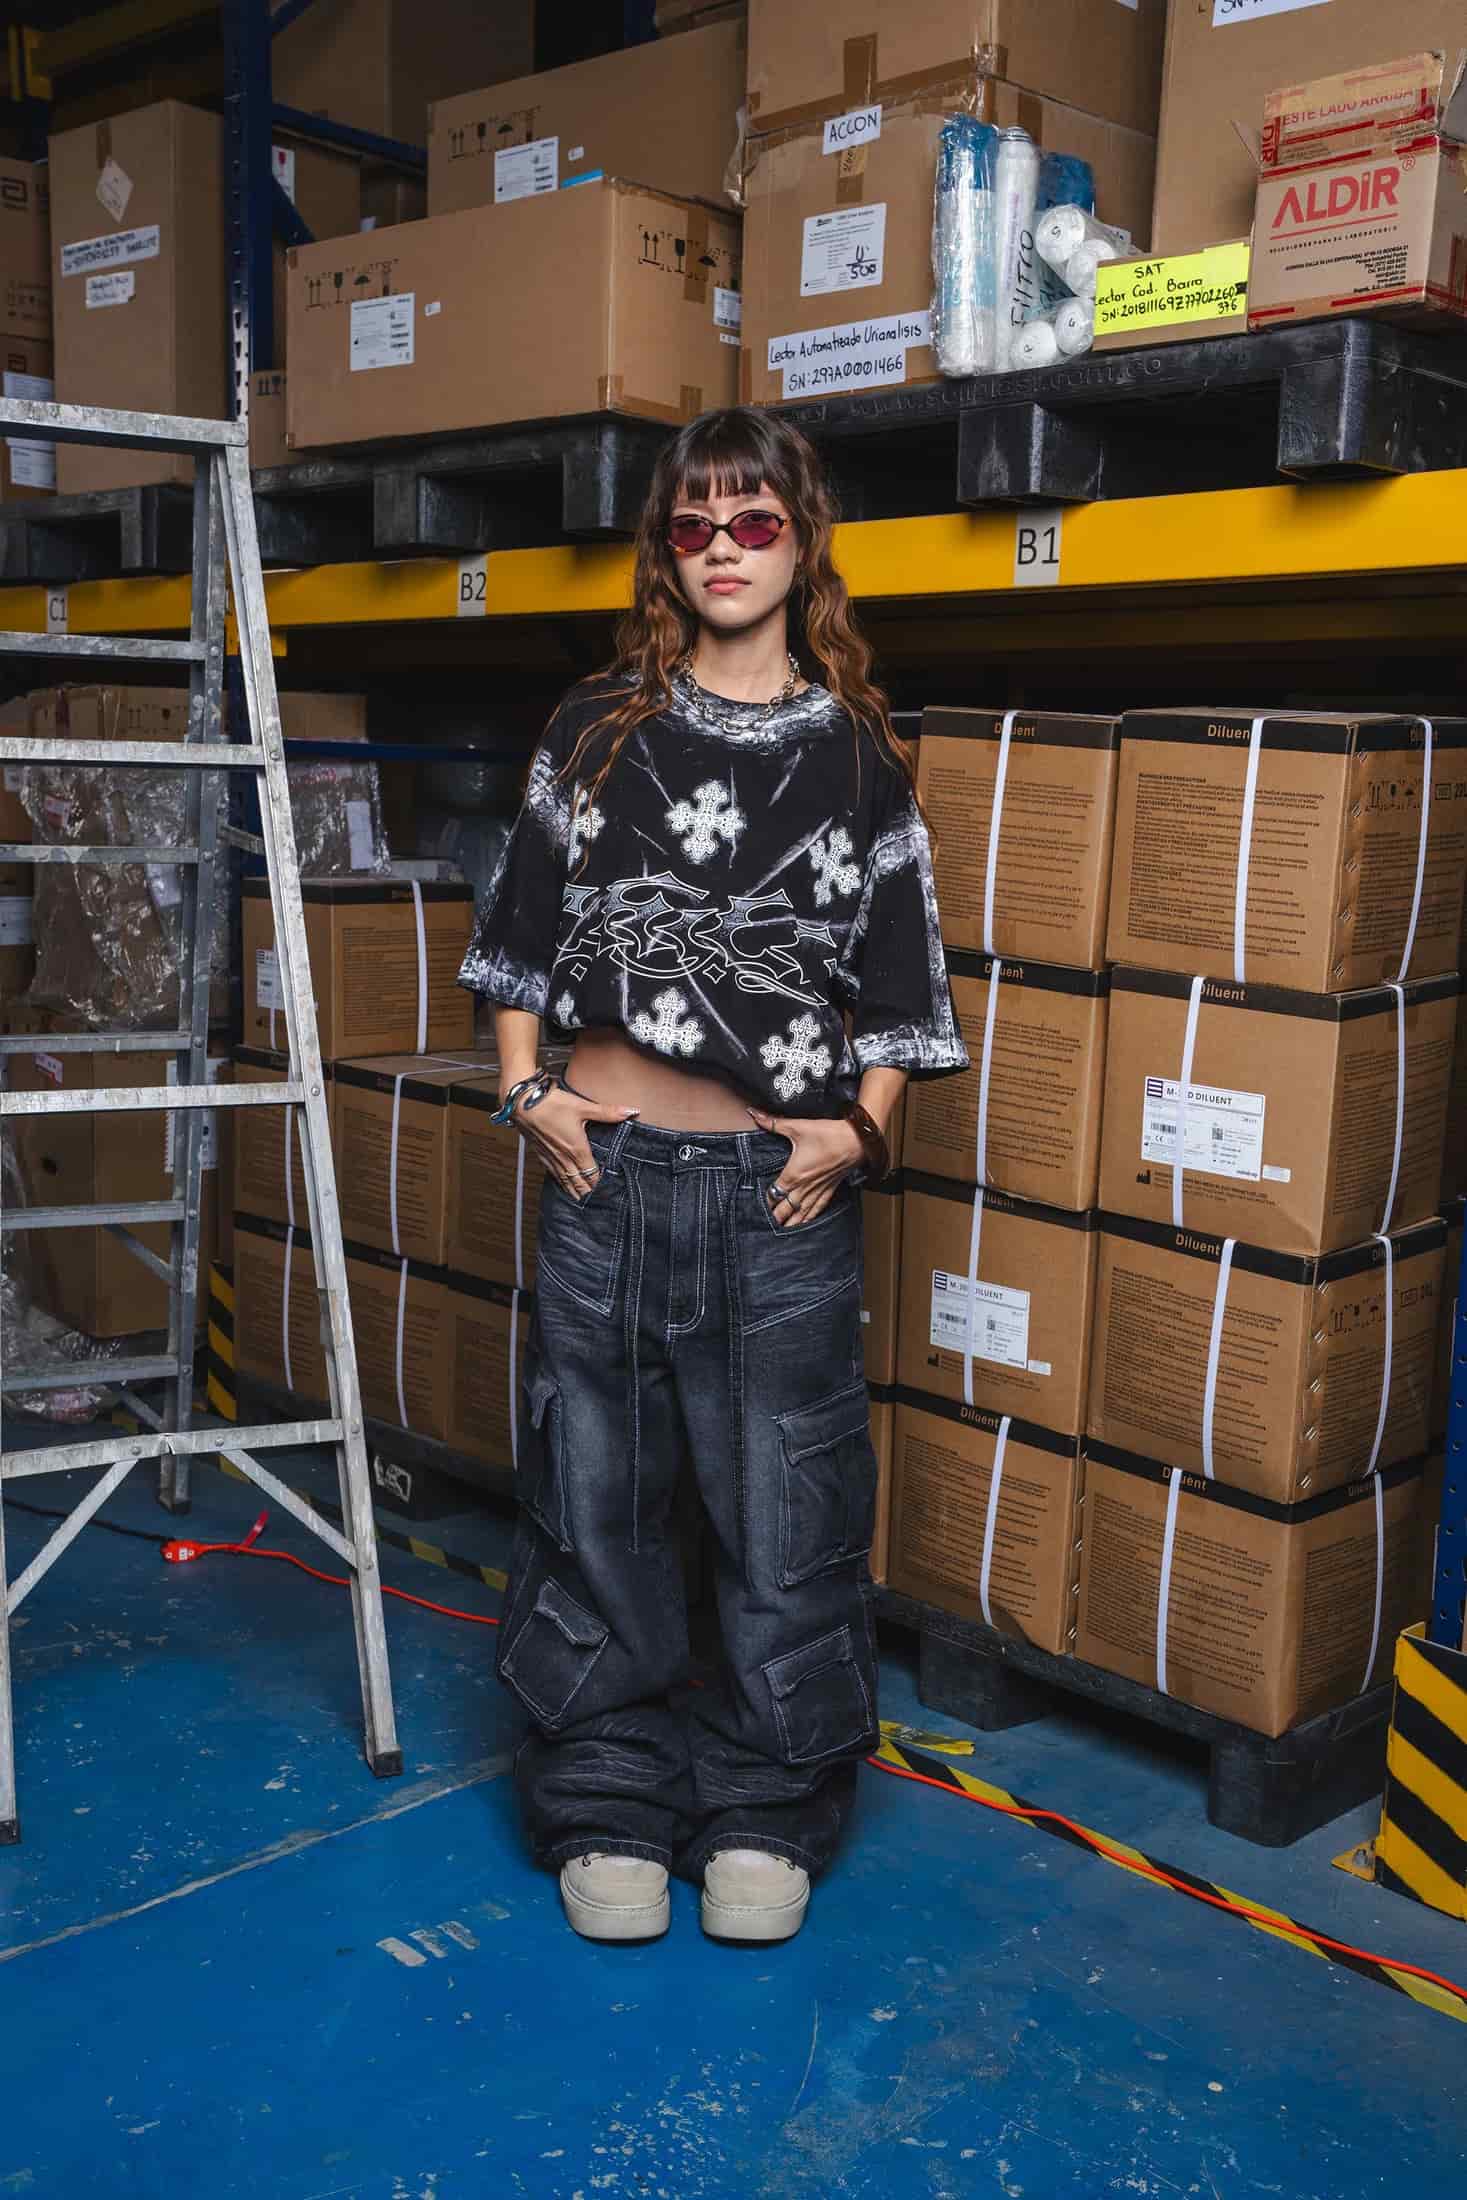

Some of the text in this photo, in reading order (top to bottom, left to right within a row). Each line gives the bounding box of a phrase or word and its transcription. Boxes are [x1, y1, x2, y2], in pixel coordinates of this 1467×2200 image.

[1134, 262, 1165, 279] SAT
[1167, 278, 1203, 292] Barra
[1016, 526, 1060, 565] B1
[460, 571, 487, 601] B2
[49, 597, 68, 622] C1
[1207, 724, 1251, 740] Diluen
[985, 962, 1023, 979] Duent
[1166, 1087, 1233, 1105] M-D DILUENT
[1175, 1232, 1221, 1257] Diluent
[960, 1407, 999, 1430] Diluent
